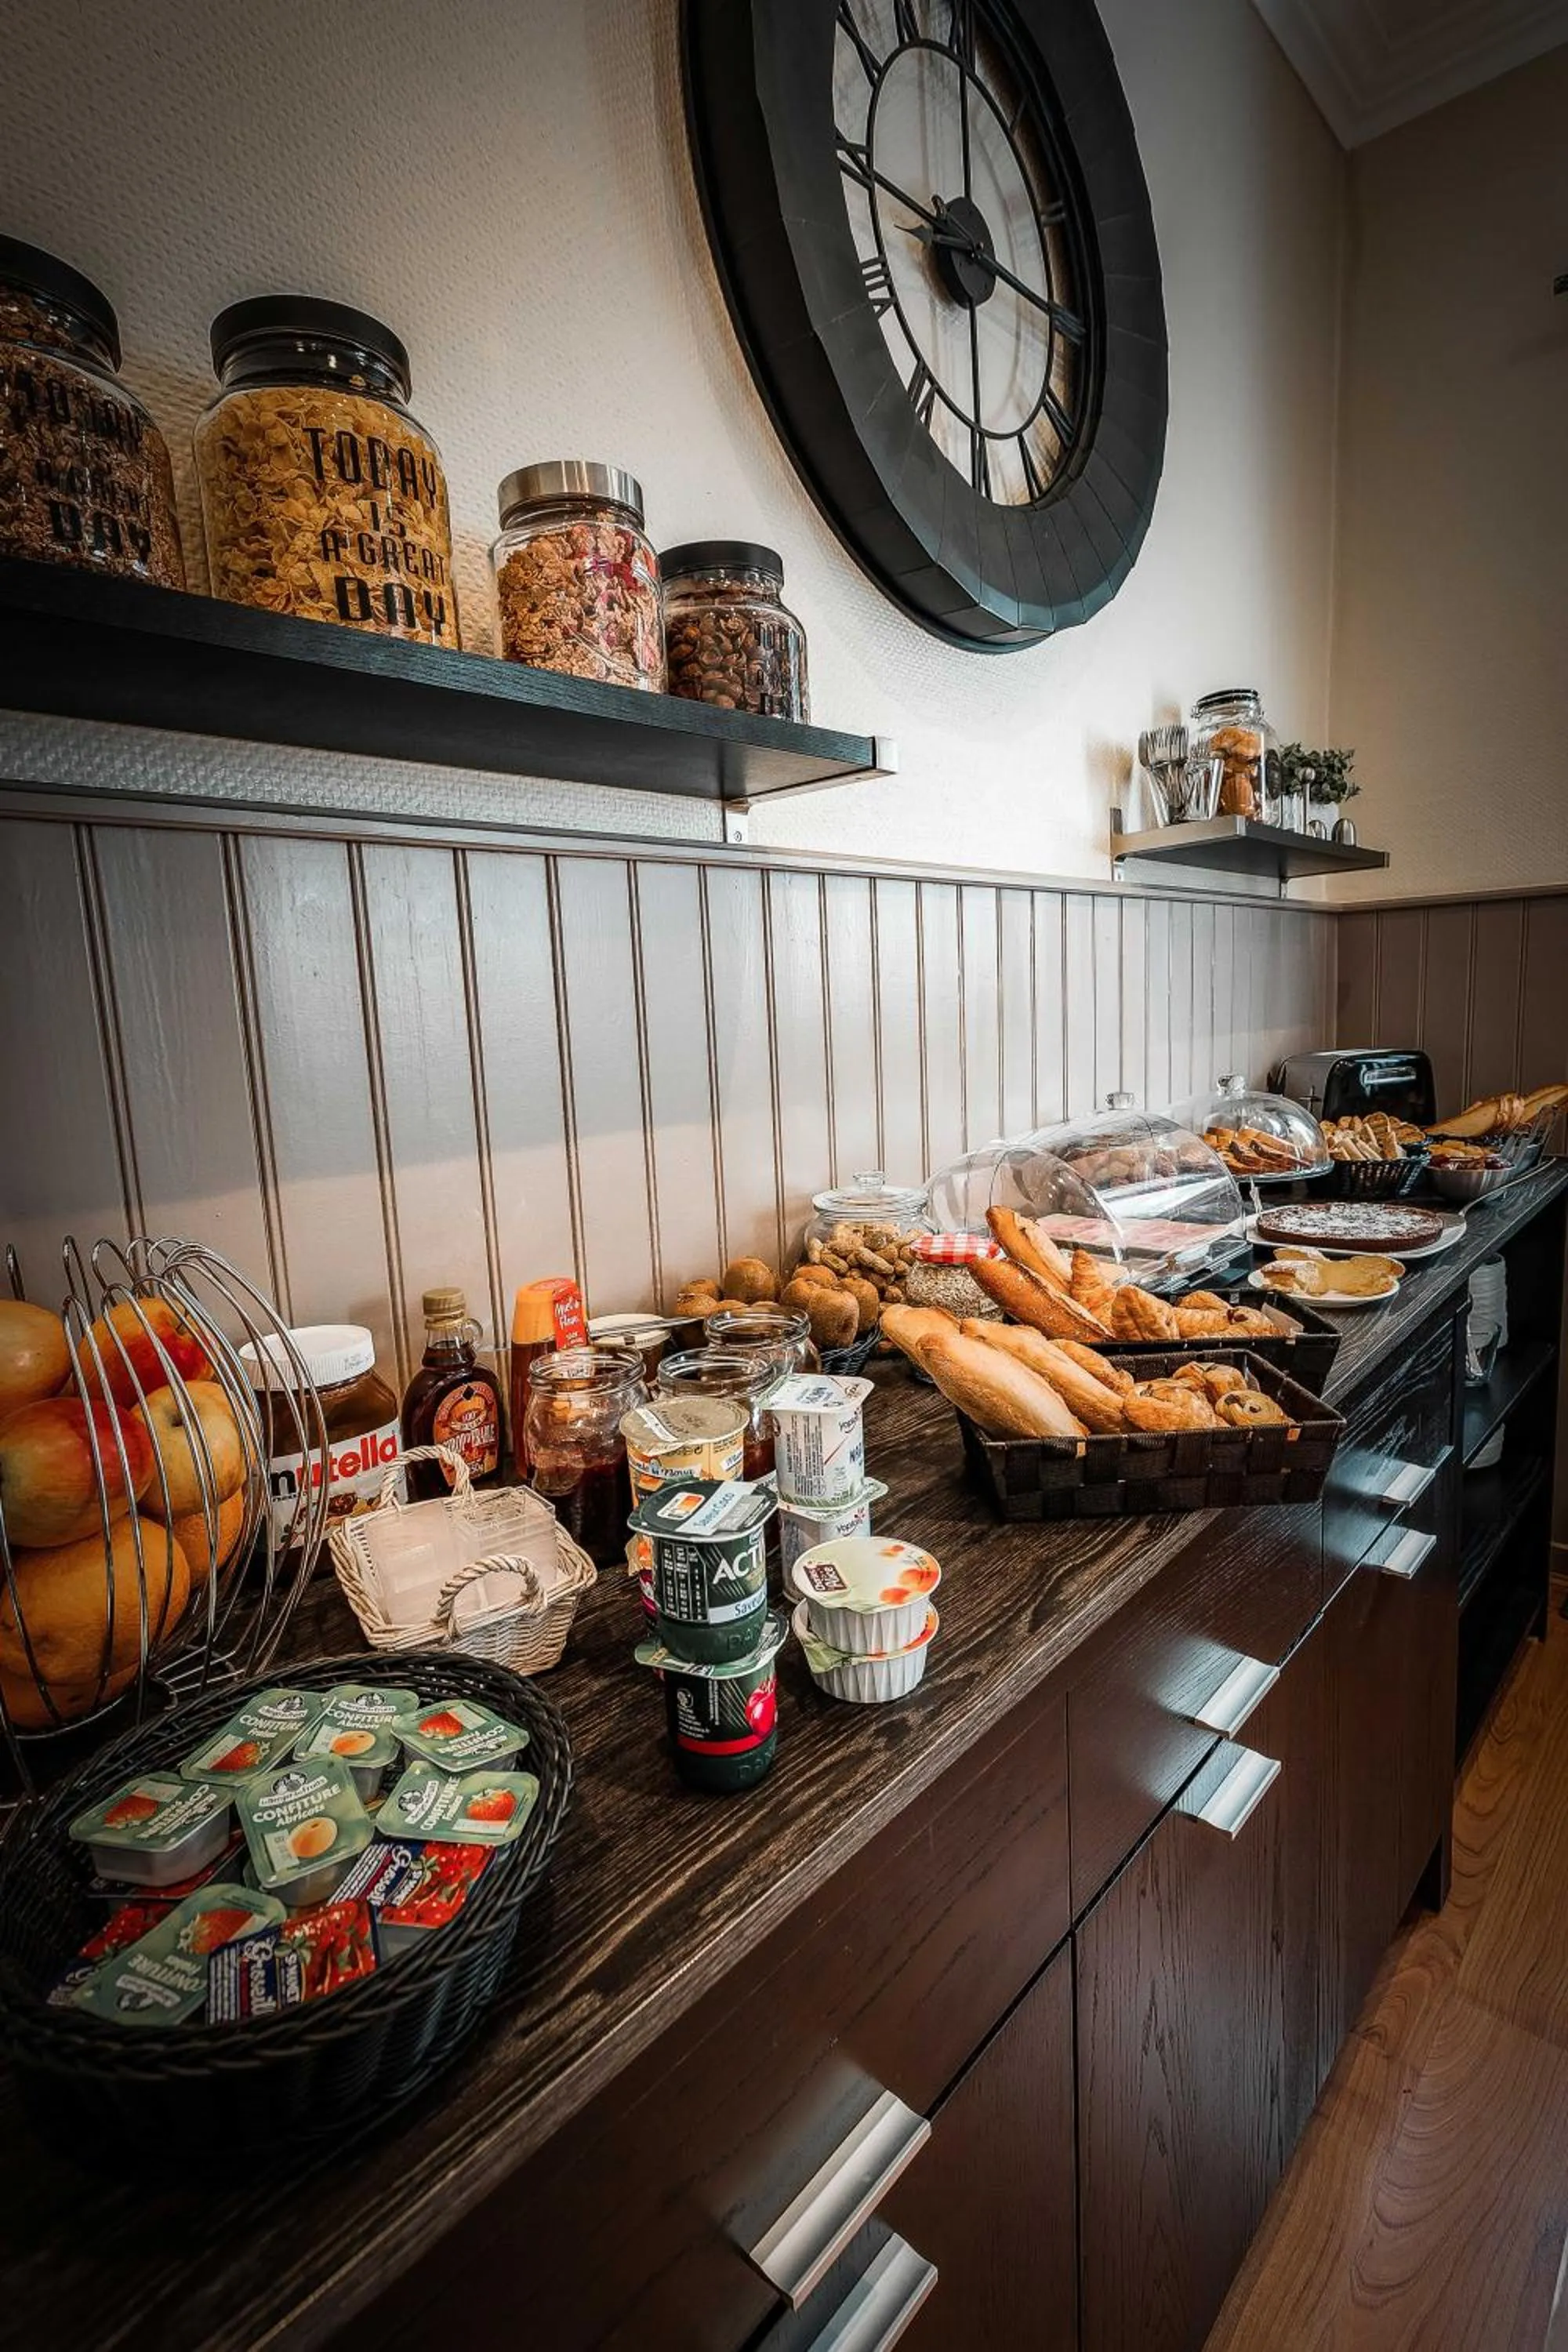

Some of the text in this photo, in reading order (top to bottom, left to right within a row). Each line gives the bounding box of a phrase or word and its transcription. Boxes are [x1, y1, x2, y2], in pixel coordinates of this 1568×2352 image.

[302, 427, 437, 510] TODAY
[370, 501, 407, 539] IS
[321, 529, 445, 586] A GREAT
[334, 575, 446, 636] DAY
[270, 1434, 397, 1496] nutella
[252, 1784, 342, 1824] CONFITURE
[275, 1804, 326, 1828] Abricots
[420, 1776, 462, 1831] CONFITURE
